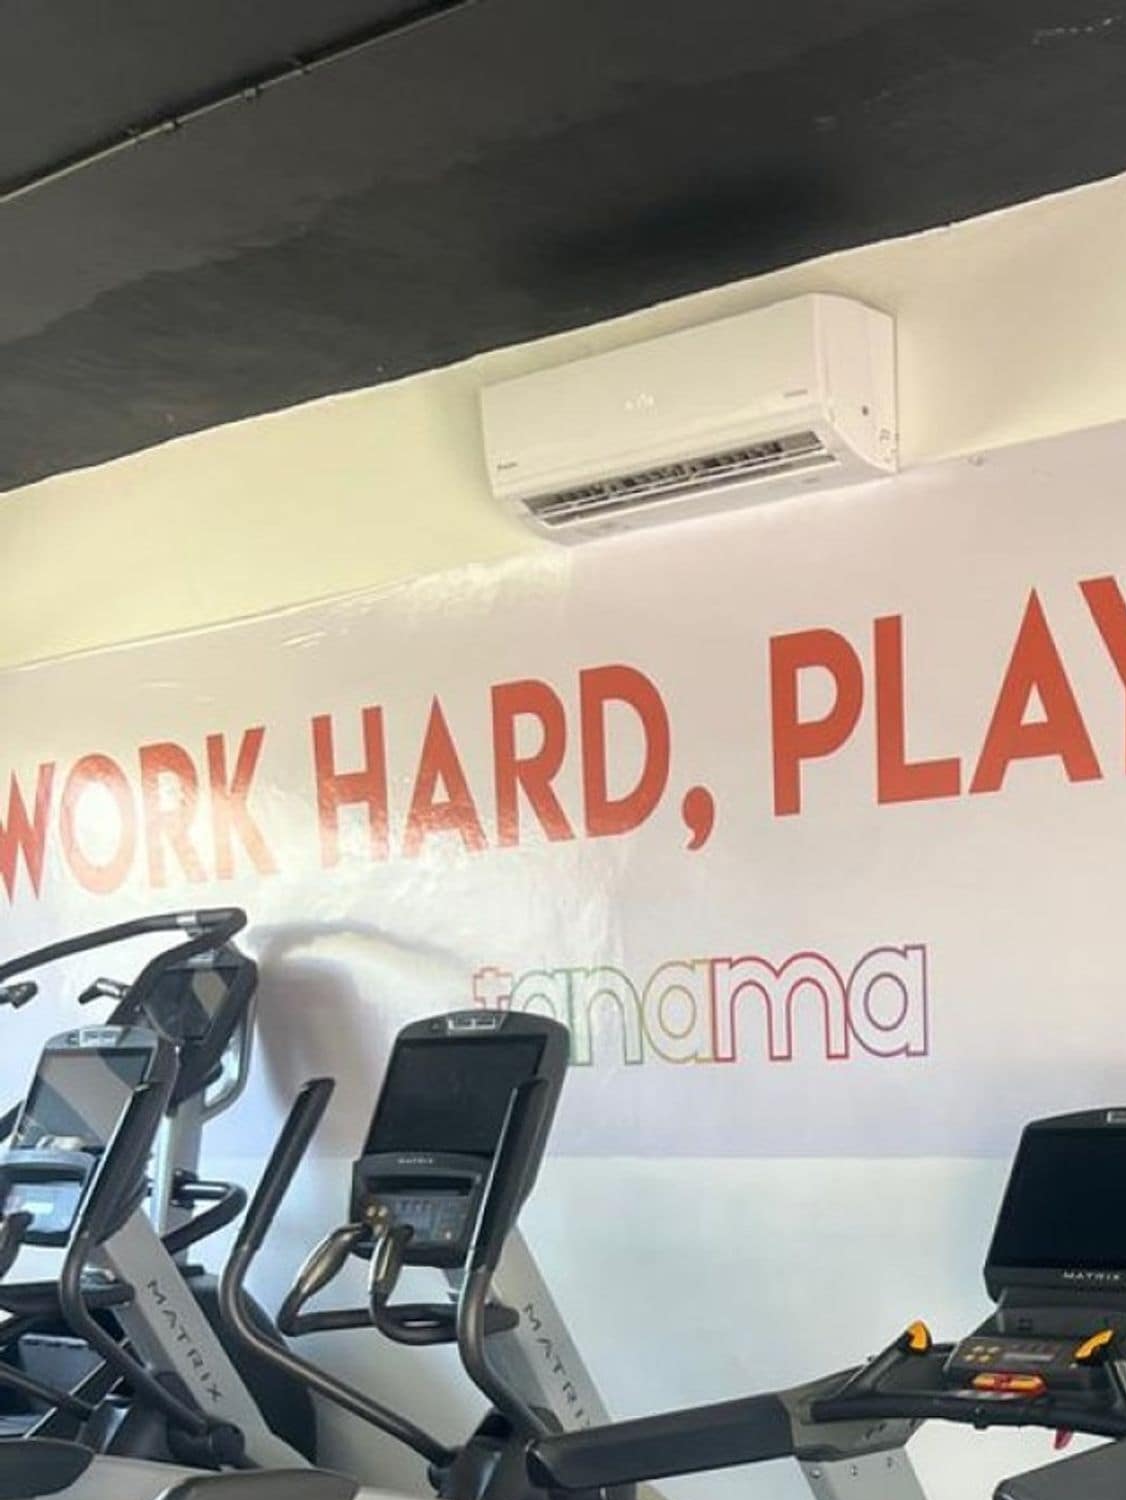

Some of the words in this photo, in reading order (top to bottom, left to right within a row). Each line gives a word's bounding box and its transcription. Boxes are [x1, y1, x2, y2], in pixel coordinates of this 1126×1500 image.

[0, 727, 276, 900] WORK
[311, 664, 715, 868] HARD,
[147, 1280, 223, 1403] MATRIX
